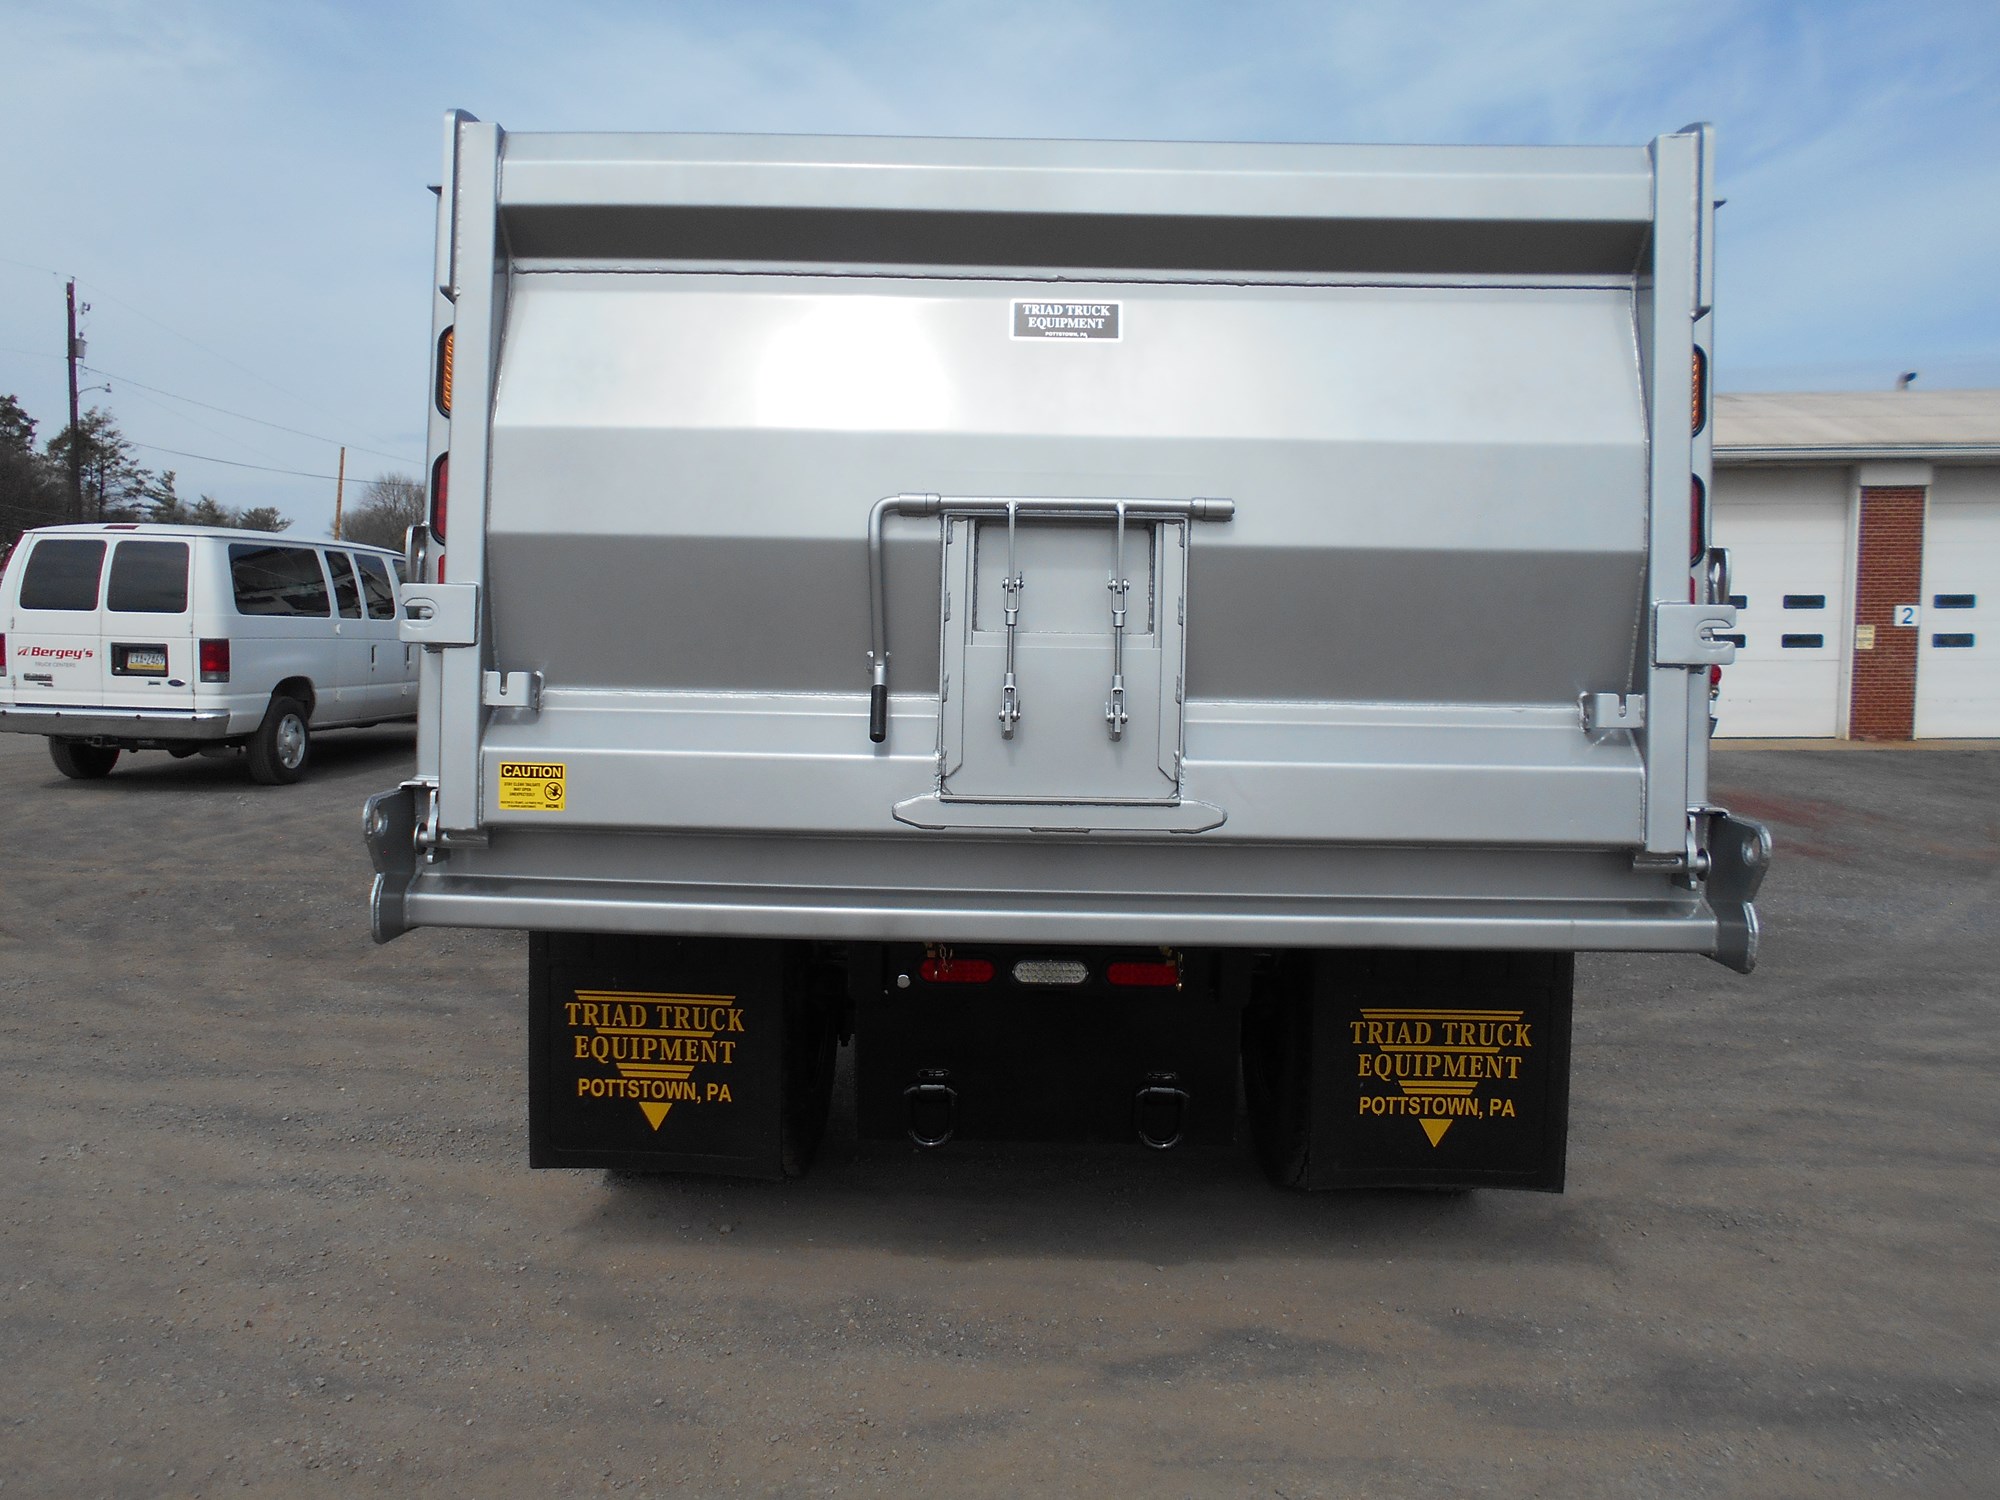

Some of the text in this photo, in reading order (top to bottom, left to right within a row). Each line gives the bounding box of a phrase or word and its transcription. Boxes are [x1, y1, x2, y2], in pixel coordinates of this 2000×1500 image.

[1022, 304, 1111, 316] TRIAD TRUCK
[1028, 317, 1105, 329] EQUIPMENT
[1902, 607, 1914, 625] 2
[31, 646, 94, 660] Bergey's
[503, 765, 562, 778] CAUTION
[565, 1003, 745, 1032] TRIAD TRUCK
[1350, 1021, 1532, 1047] TRIAD TRUCK
[574, 1035, 736, 1064] EQUIPMENT
[1357, 1053, 1522, 1082] EQUIPMENT
[578, 1078, 732, 1104] POTTSTOWN, PA
[1359, 1096, 1516, 1120] POTTSTOWN, PA
